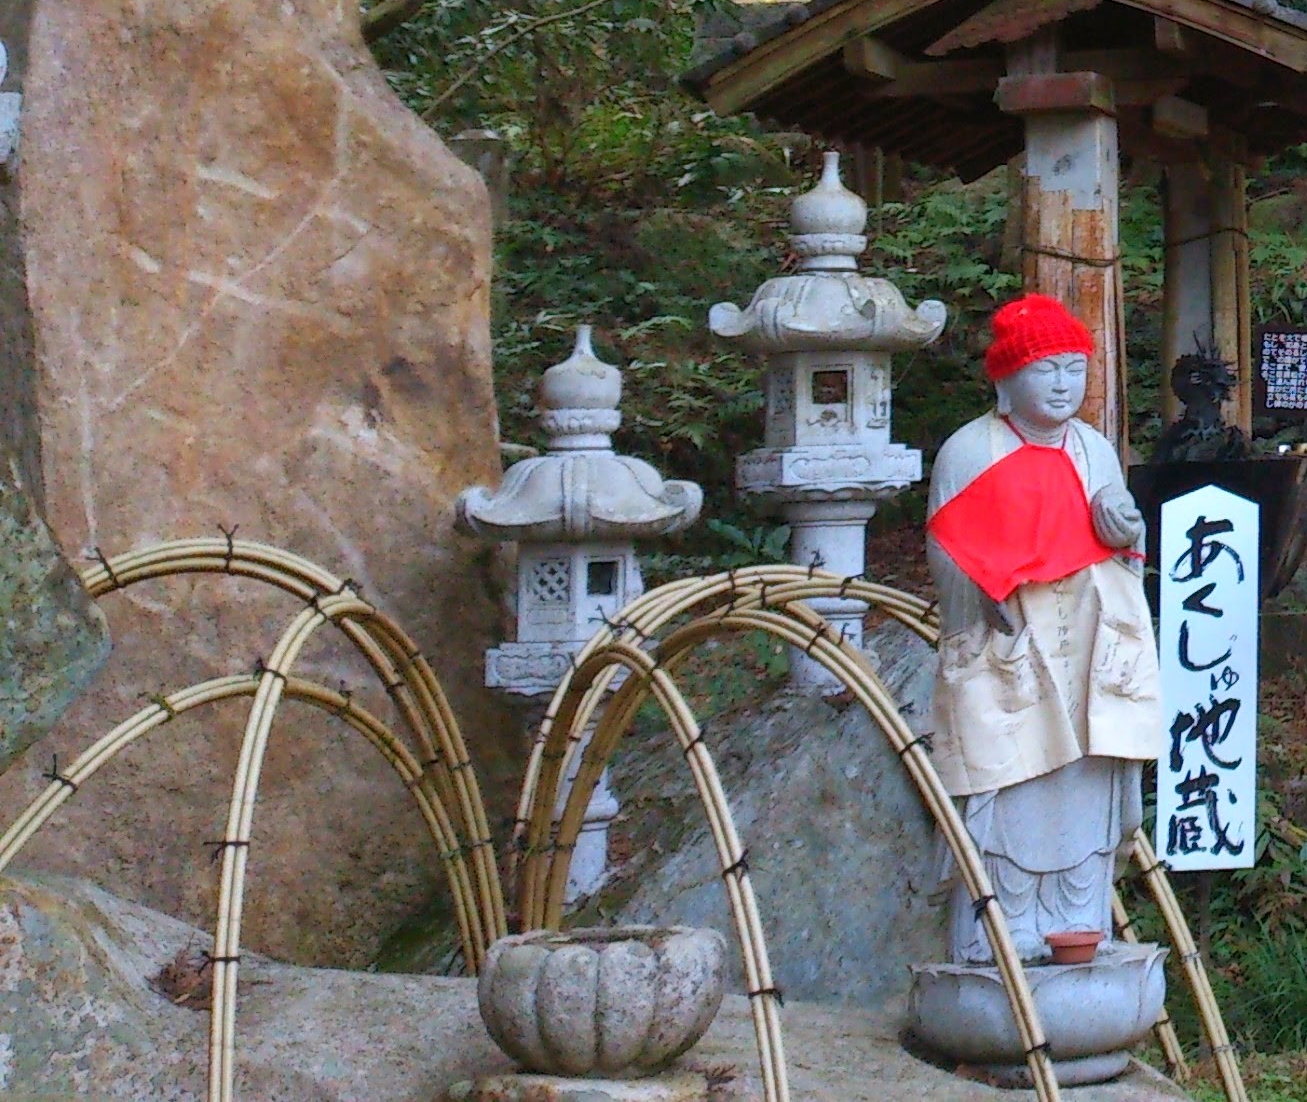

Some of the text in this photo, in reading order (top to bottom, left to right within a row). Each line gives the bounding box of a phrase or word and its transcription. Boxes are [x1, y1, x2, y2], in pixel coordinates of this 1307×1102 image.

[1166, 515, 1244, 857] あくしゅ地蔵
